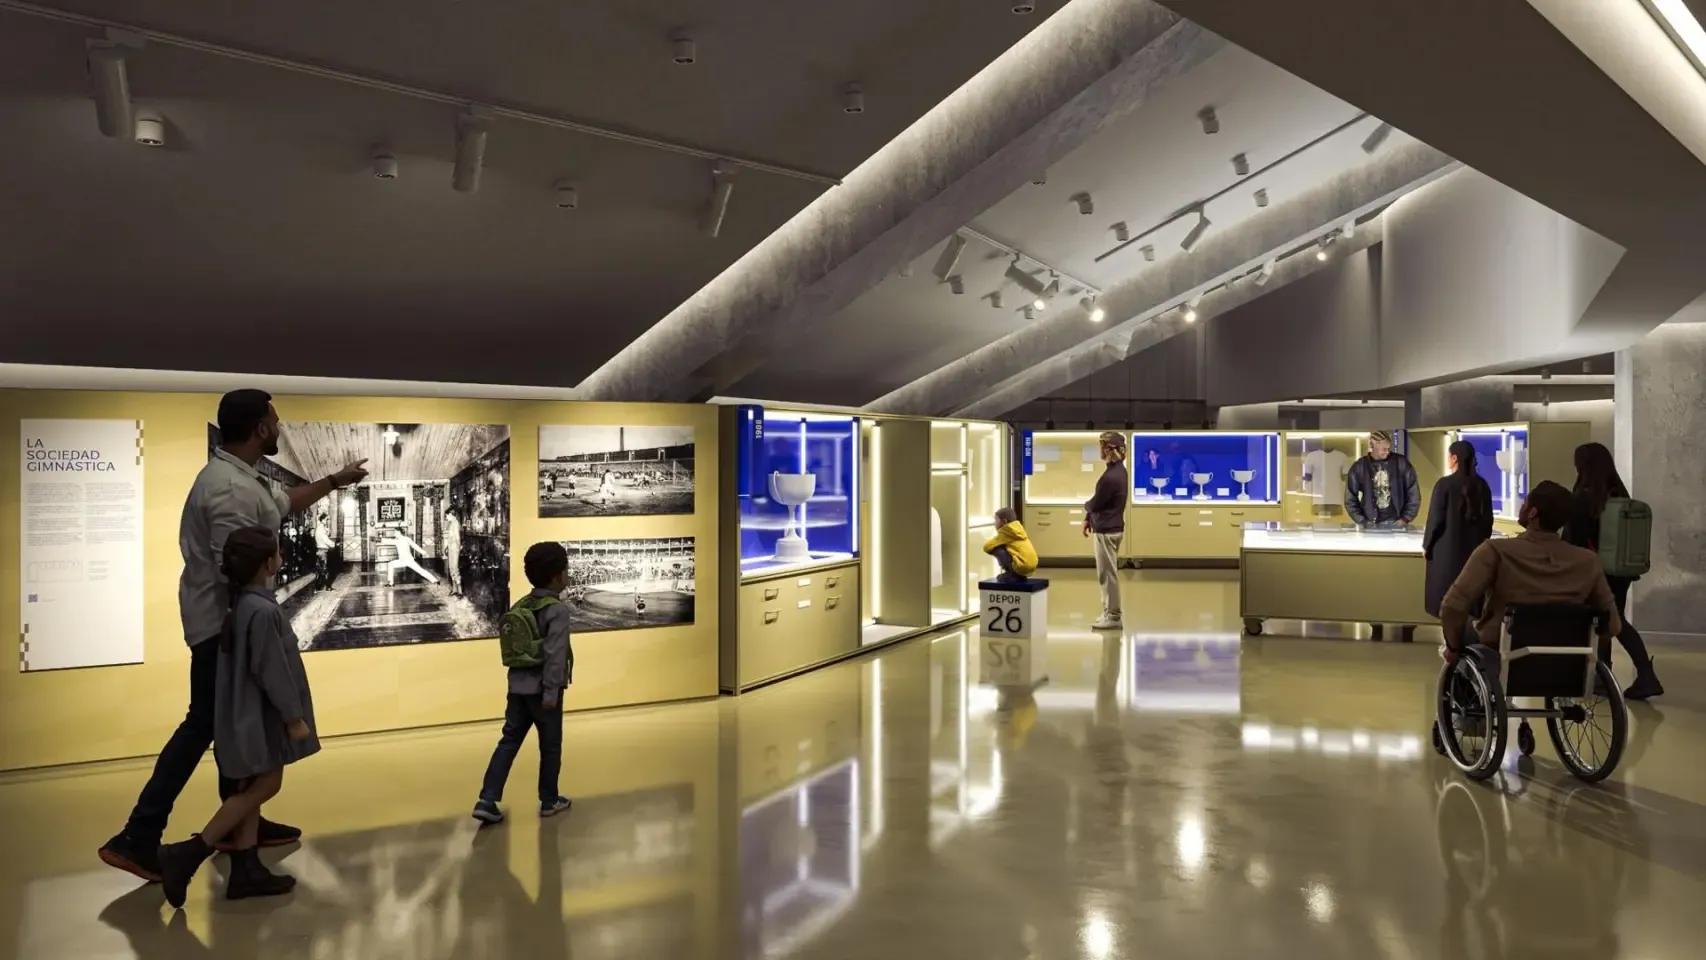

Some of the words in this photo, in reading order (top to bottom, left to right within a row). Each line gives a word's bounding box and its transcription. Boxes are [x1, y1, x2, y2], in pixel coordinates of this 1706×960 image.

[26, 438, 44, 448] LA
[26, 450, 100, 460] SOCIEDAD
[26, 459, 116, 472] GIMNÁSTICA
[989, 594, 1021, 604] DEPOR
[988, 606, 1022, 633] 26
